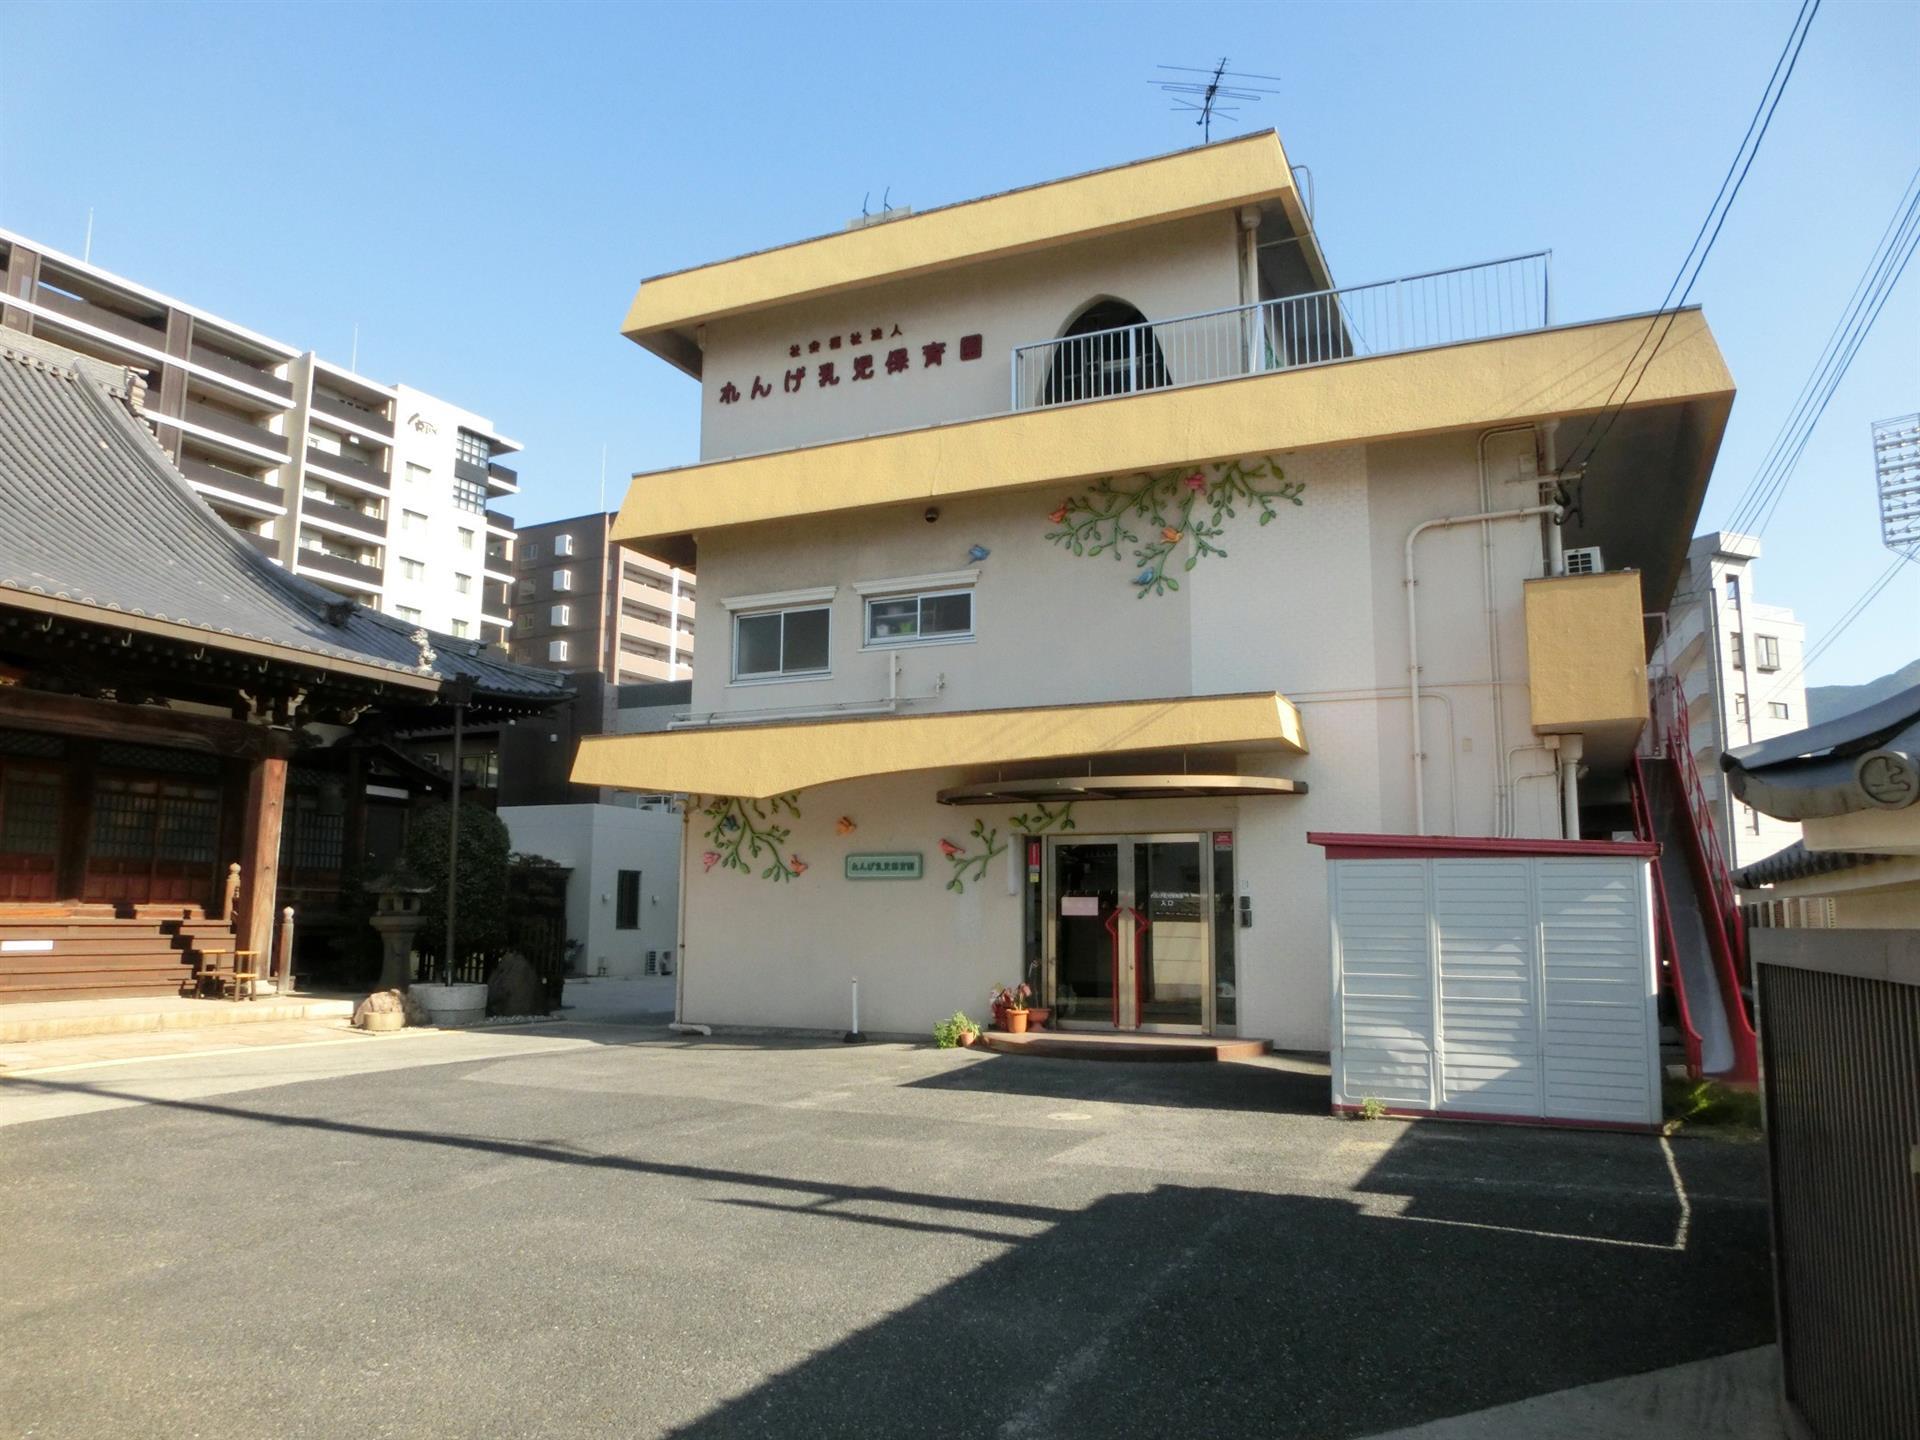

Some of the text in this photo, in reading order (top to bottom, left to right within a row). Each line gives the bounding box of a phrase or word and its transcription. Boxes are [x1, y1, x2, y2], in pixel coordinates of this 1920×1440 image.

[789, 323, 903, 358] 社会福祉法人
[718, 333, 984, 405] れんげ乳児保育園
